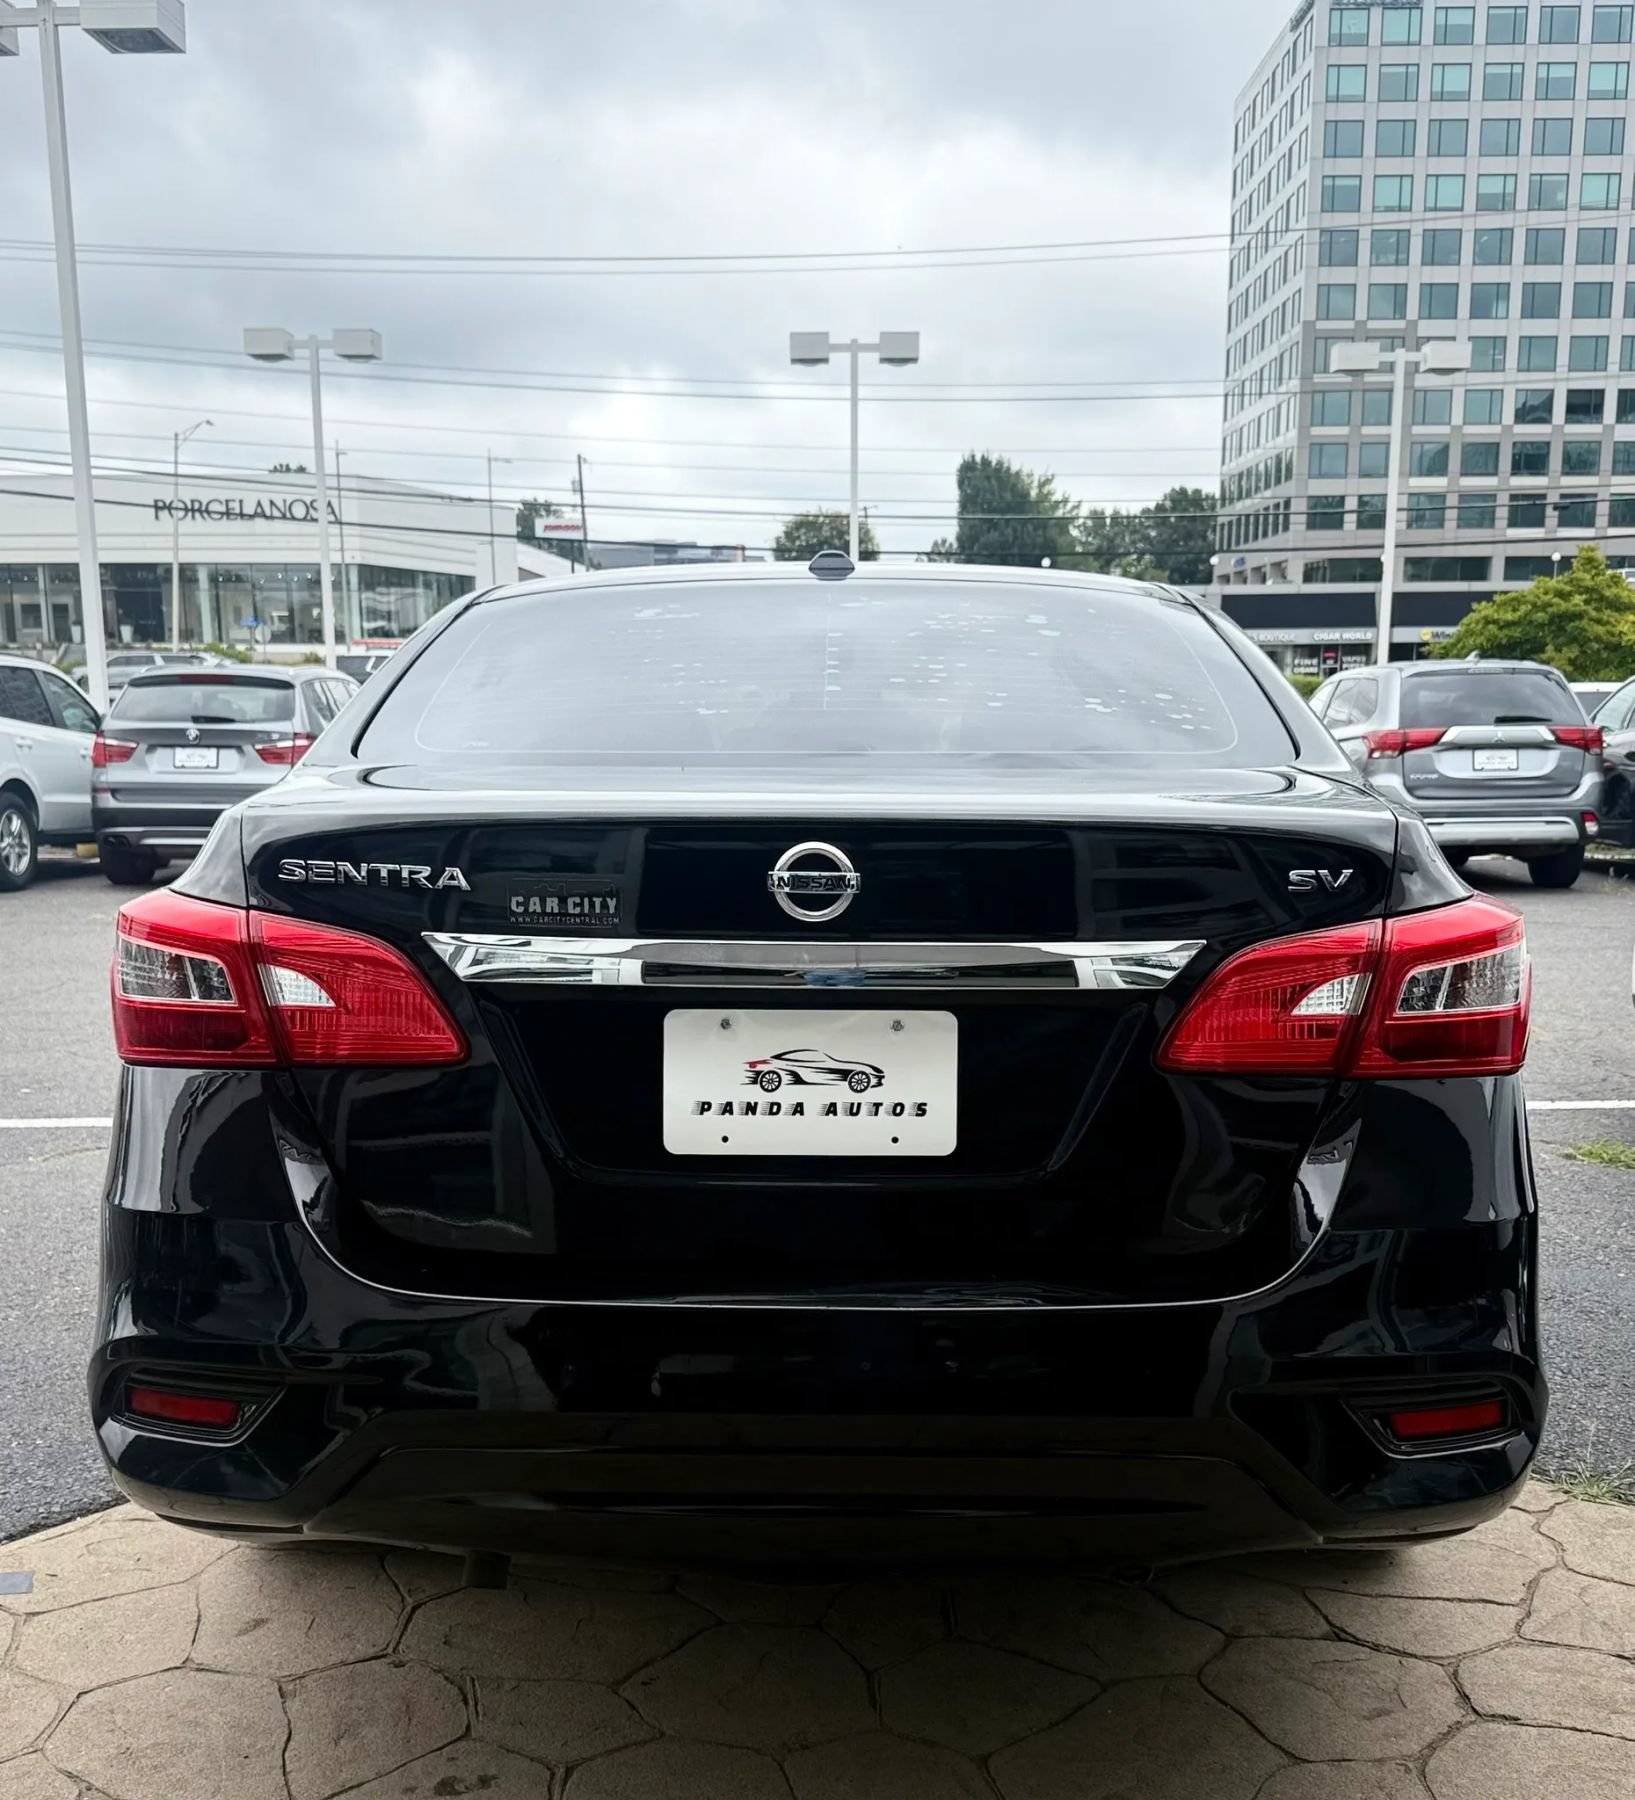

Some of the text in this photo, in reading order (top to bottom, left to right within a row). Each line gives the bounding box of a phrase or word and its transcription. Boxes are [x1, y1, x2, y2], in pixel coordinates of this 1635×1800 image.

[153, 498, 339, 522] PORCELANOSA
[1313, 631, 1373, 641] CIGAR WORLD
[278, 858, 472, 892] SENTRA
[775, 873, 853, 890] NISSAN
[1287, 869, 1354, 893] SV
[510, 896, 617, 914] CAR CITY
[508, 915, 620, 925] WWW.CARCITYCENTRAL.COM
[692, 1101, 928, 1118] PANDA AUTOS
